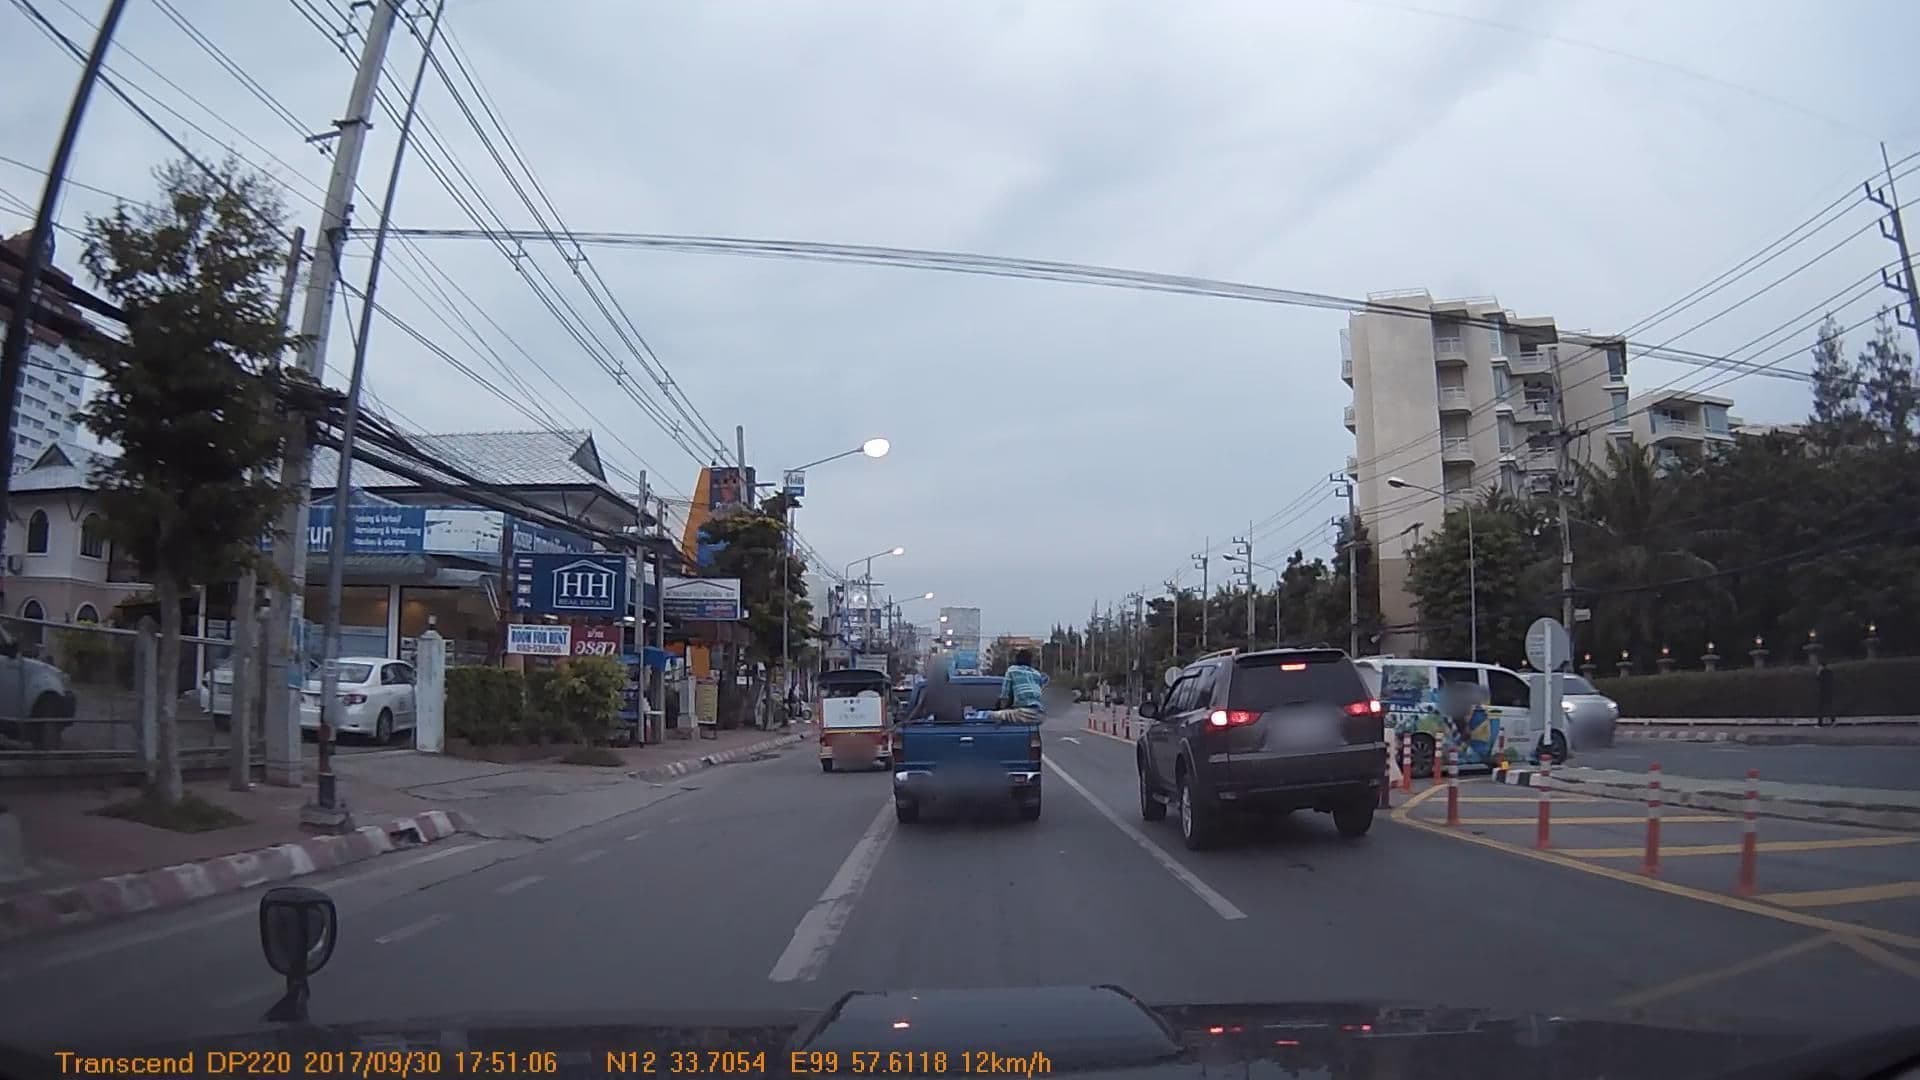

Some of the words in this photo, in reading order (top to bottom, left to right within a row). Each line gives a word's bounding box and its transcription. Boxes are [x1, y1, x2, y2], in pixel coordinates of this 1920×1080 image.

[560, 572, 610, 598] HH
[512, 630, 532, 643] ROOM
[533, 630, 548, 644] FOR
[549, 631, 568, 646] RENT
